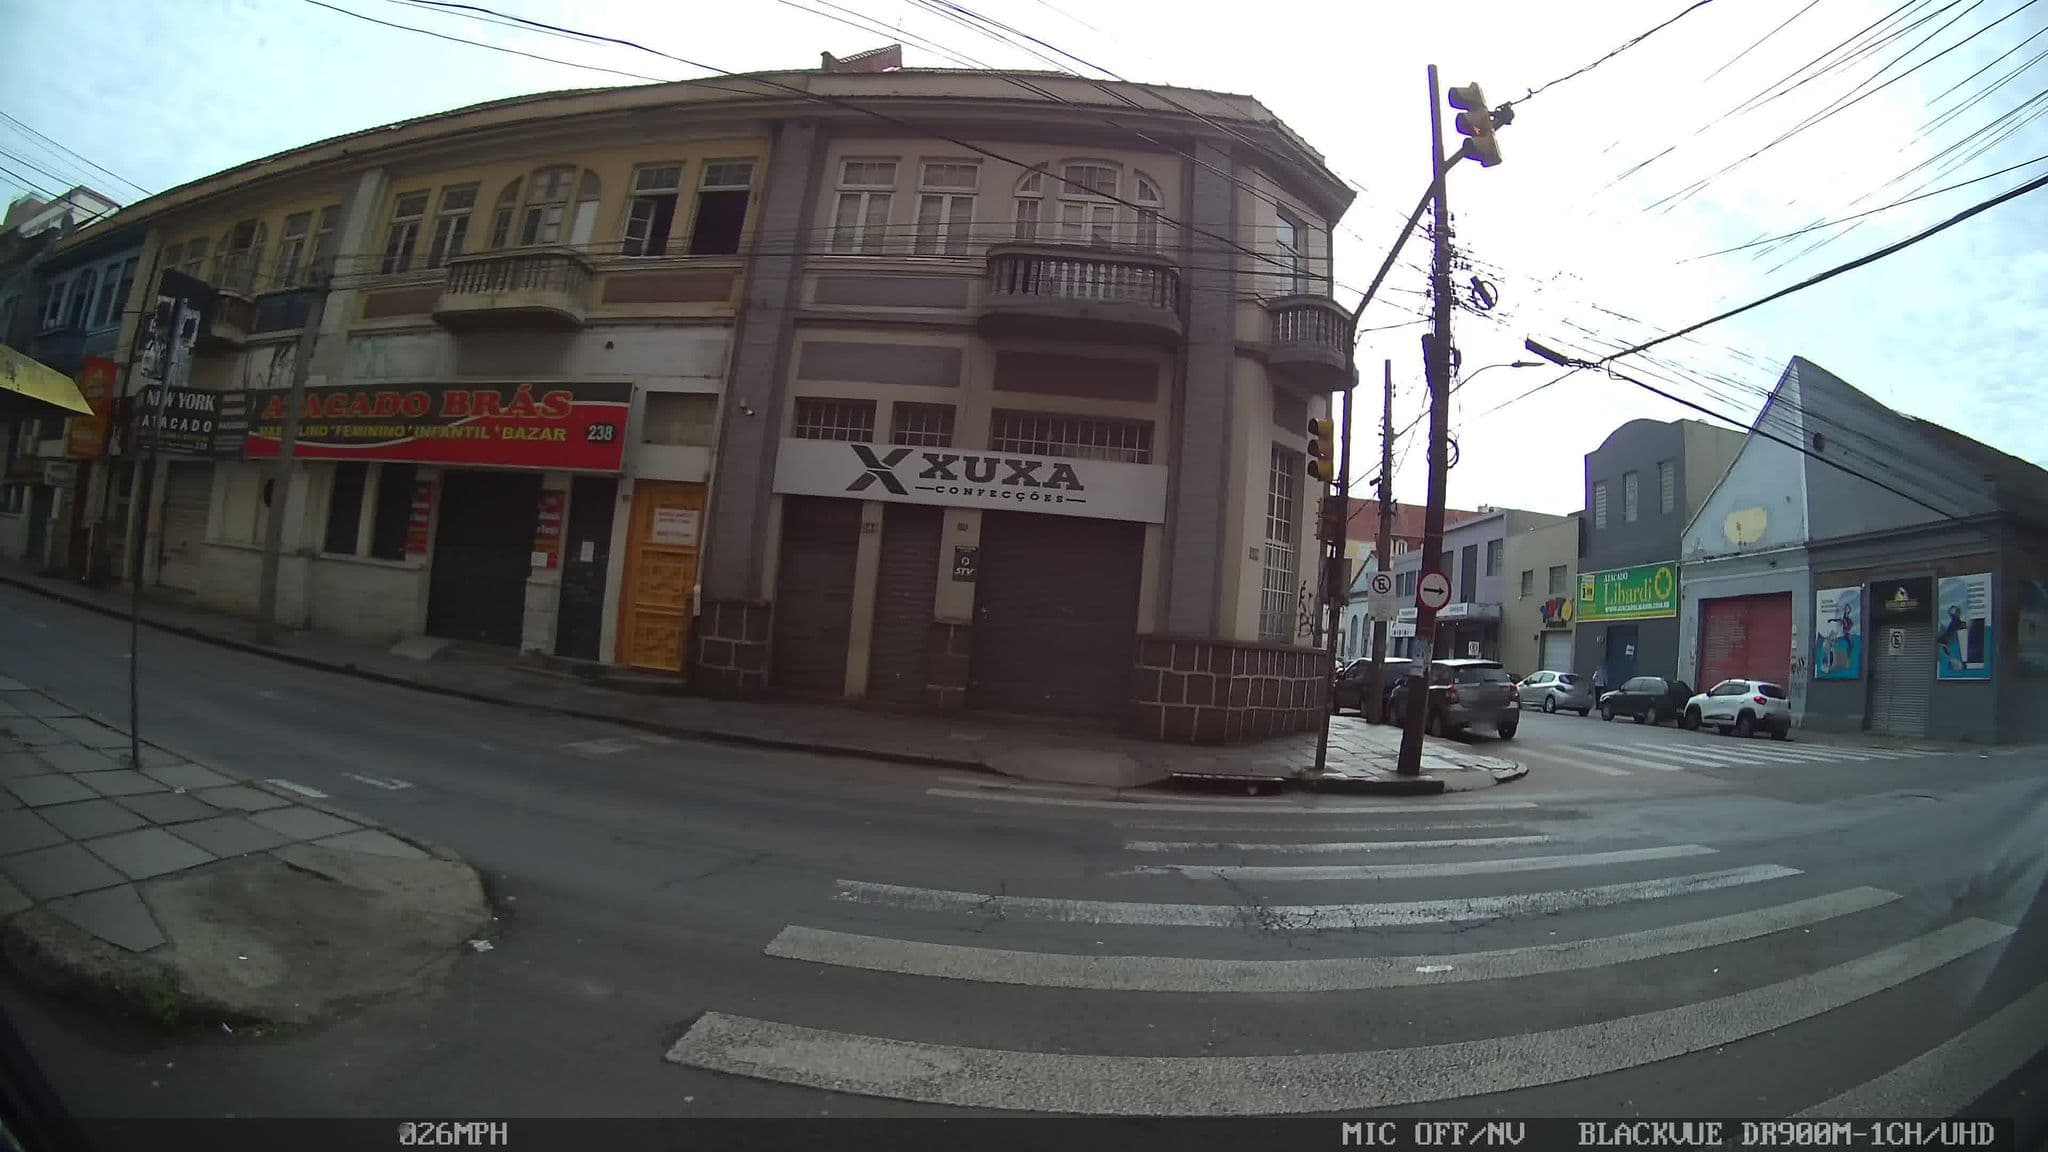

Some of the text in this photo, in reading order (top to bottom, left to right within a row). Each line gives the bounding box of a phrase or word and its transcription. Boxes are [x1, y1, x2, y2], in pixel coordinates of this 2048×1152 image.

[179, 392, 216, 411] YORK
[439, 384, 573, 419] BRÁS
[502, 426, 568, 441] BAZAR
[586, 424, 614, 440] 238
[919, 452, 1085, 492] XUXA
[935, 485, 1064, 504] CONFECÇÕES
[1604, 577, 1652, 605] Libardi
